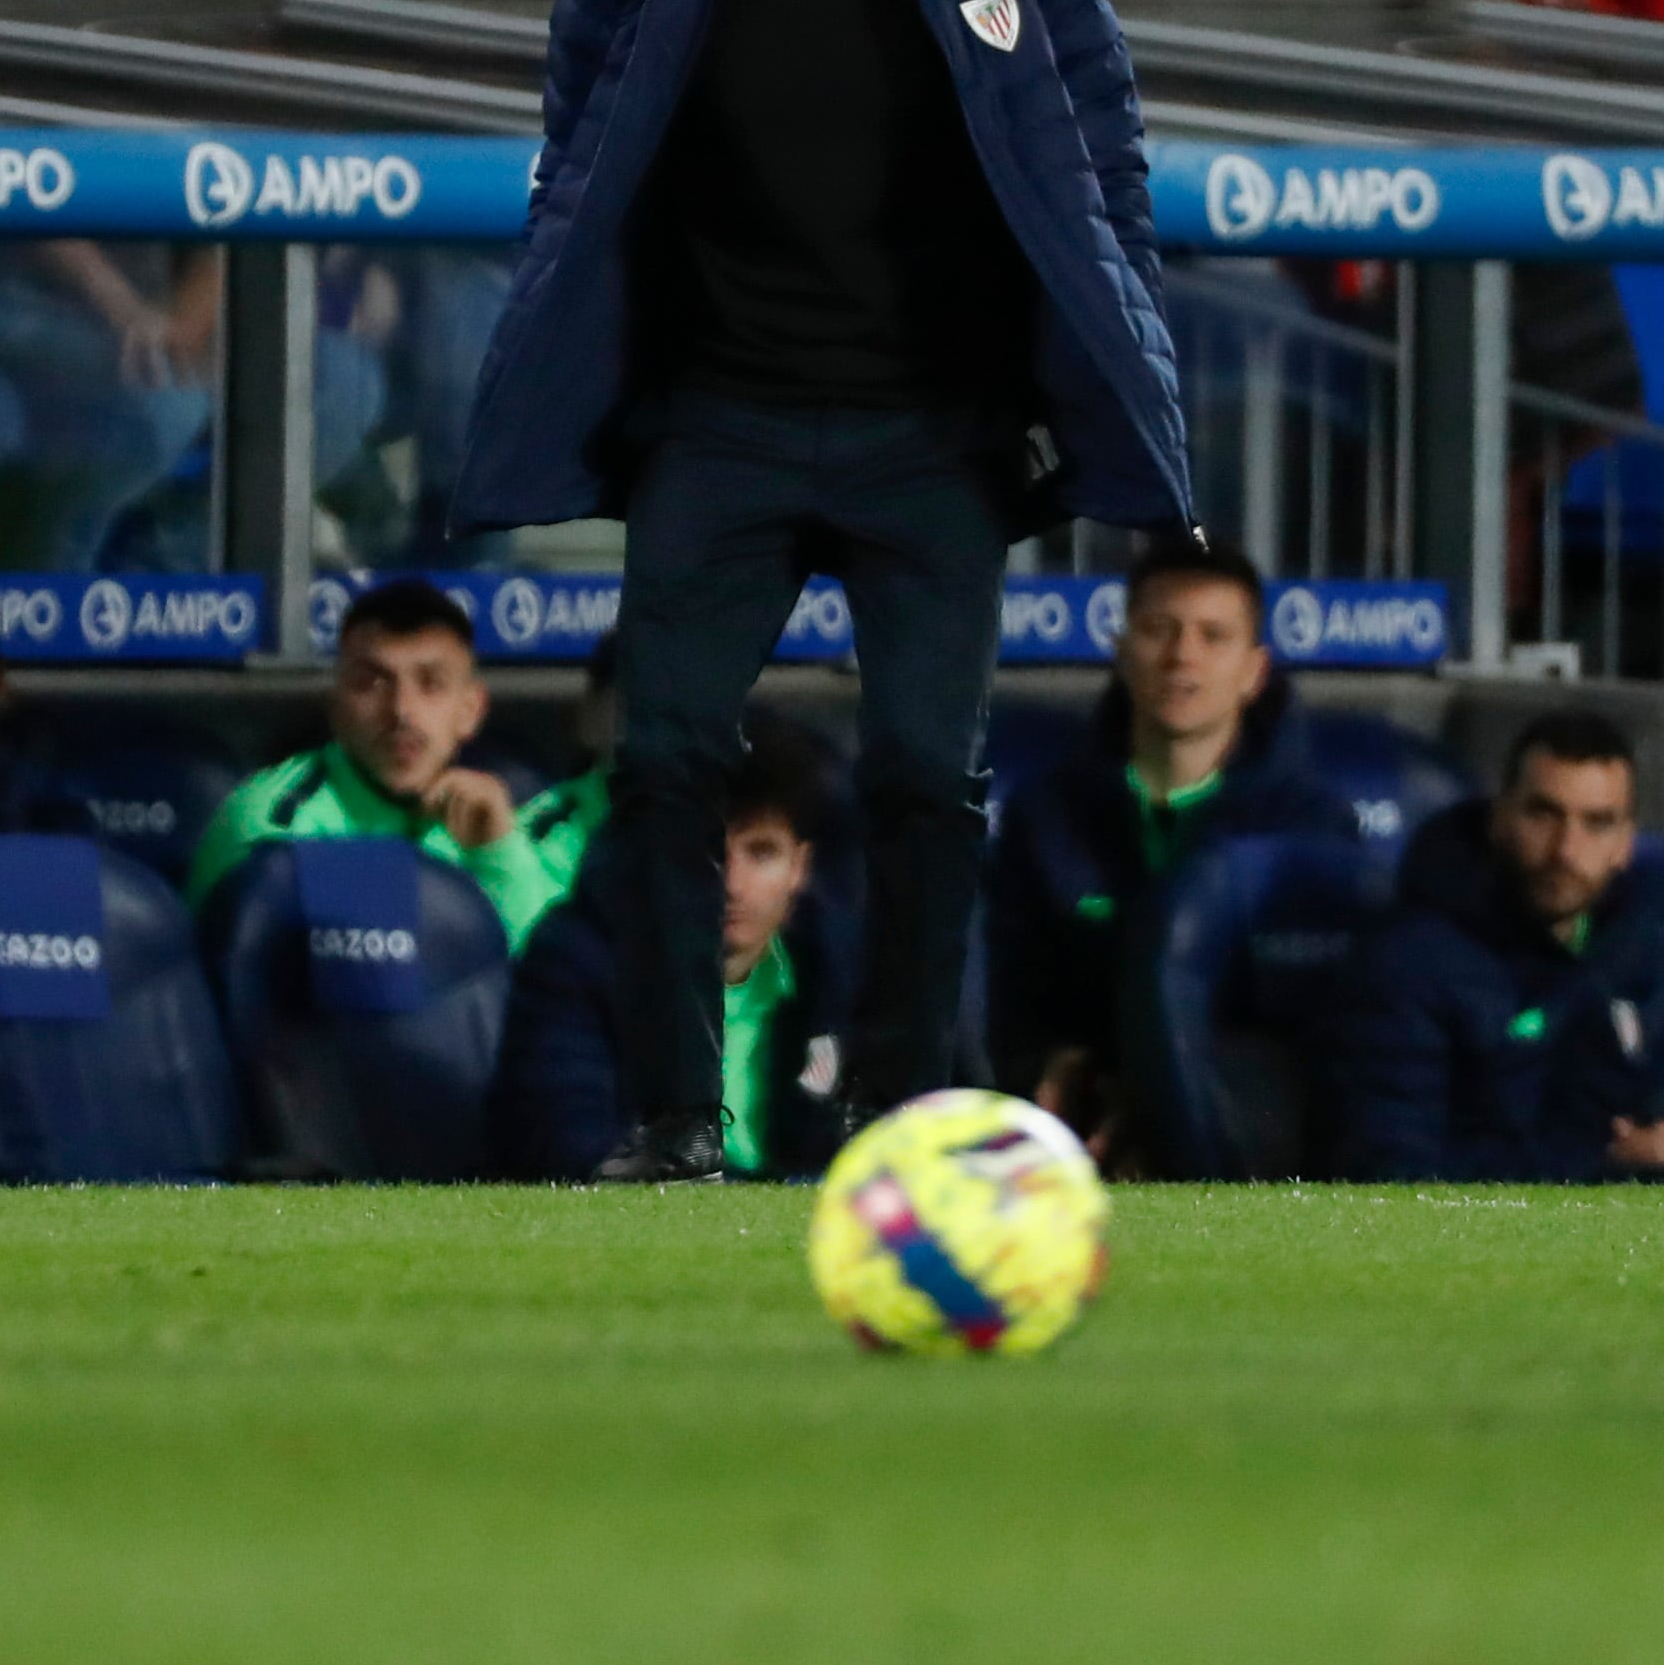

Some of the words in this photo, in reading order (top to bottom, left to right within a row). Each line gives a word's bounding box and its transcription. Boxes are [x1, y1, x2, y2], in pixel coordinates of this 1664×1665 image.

[253, 154, 421, 220] AMPO
[1274, 166, 1440, 231] AMPO
[134, 592, 257, 640] AMPO
[1321, 596, 1444, 652] AMPO
